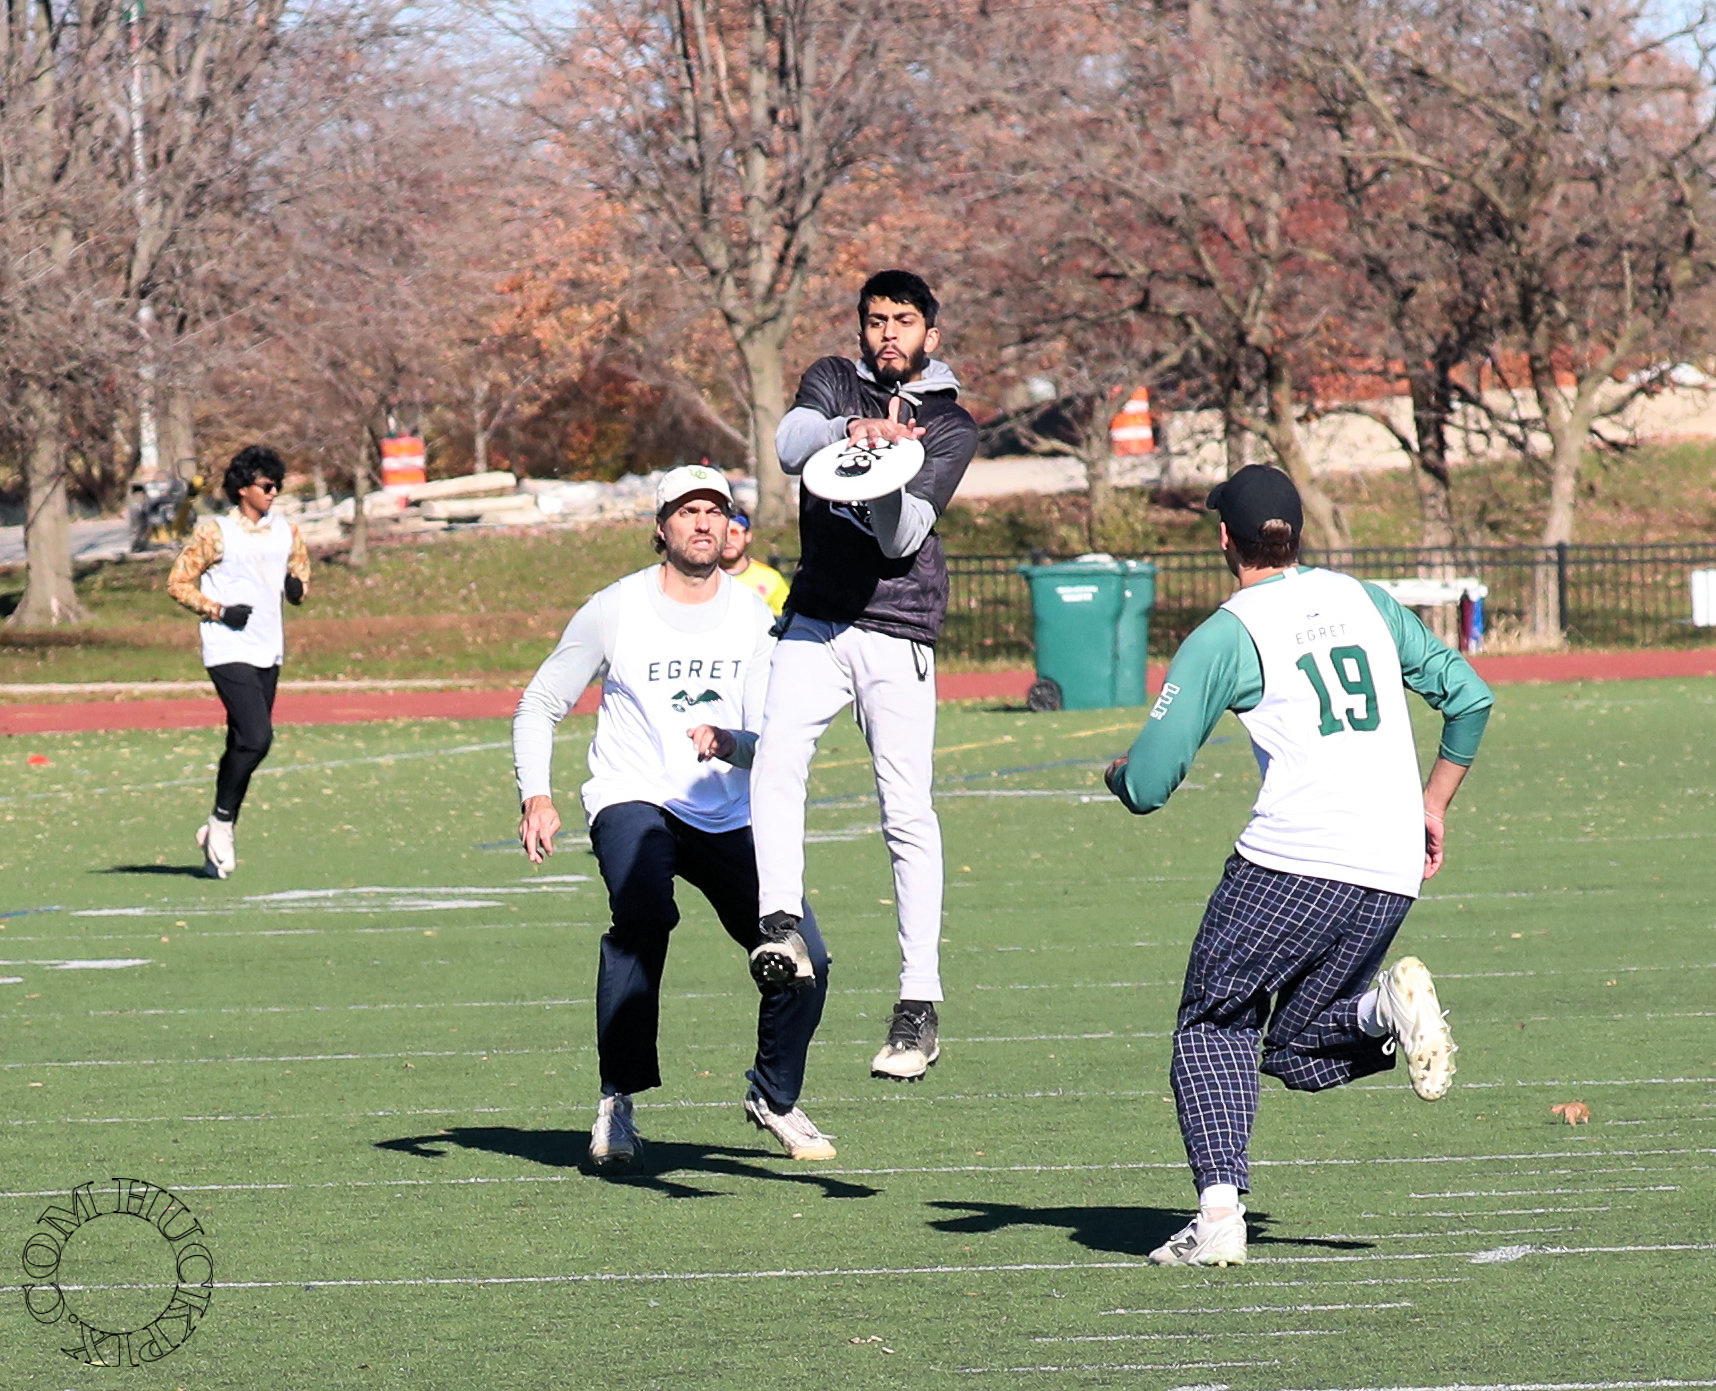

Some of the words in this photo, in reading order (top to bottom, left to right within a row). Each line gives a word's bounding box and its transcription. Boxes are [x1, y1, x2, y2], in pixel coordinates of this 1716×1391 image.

[1295, 623, 1346, 645] EGRET
[648, 659, 742, 681] EGRET
[1295, 644, 1381, 737] 19
